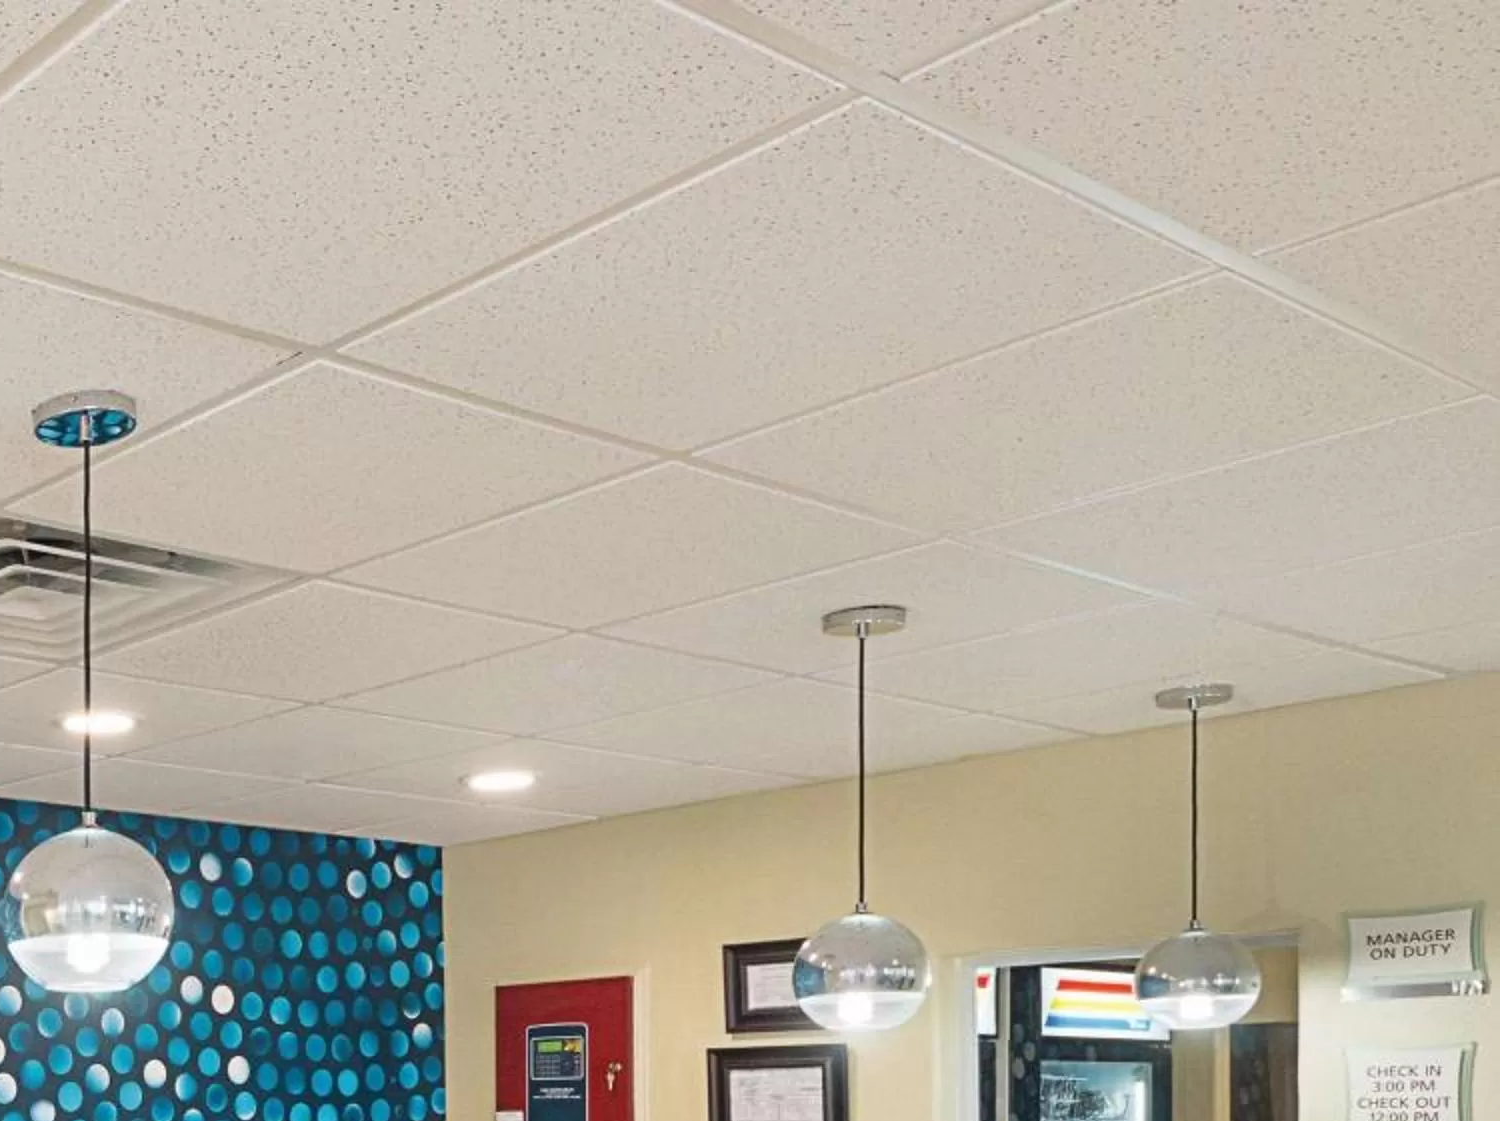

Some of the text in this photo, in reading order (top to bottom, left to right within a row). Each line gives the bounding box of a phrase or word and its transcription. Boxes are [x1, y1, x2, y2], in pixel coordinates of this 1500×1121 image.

[1366, 928, 1456, 945] MANAGER
[1369, 943, 1451, 960] ON DUTY
[1366, 1064, 1441, 1078] CHECK IN
[1410, 1080, 1435, 1093] PM
[1356, 1096, 1451, 1109] CHECK OUT
